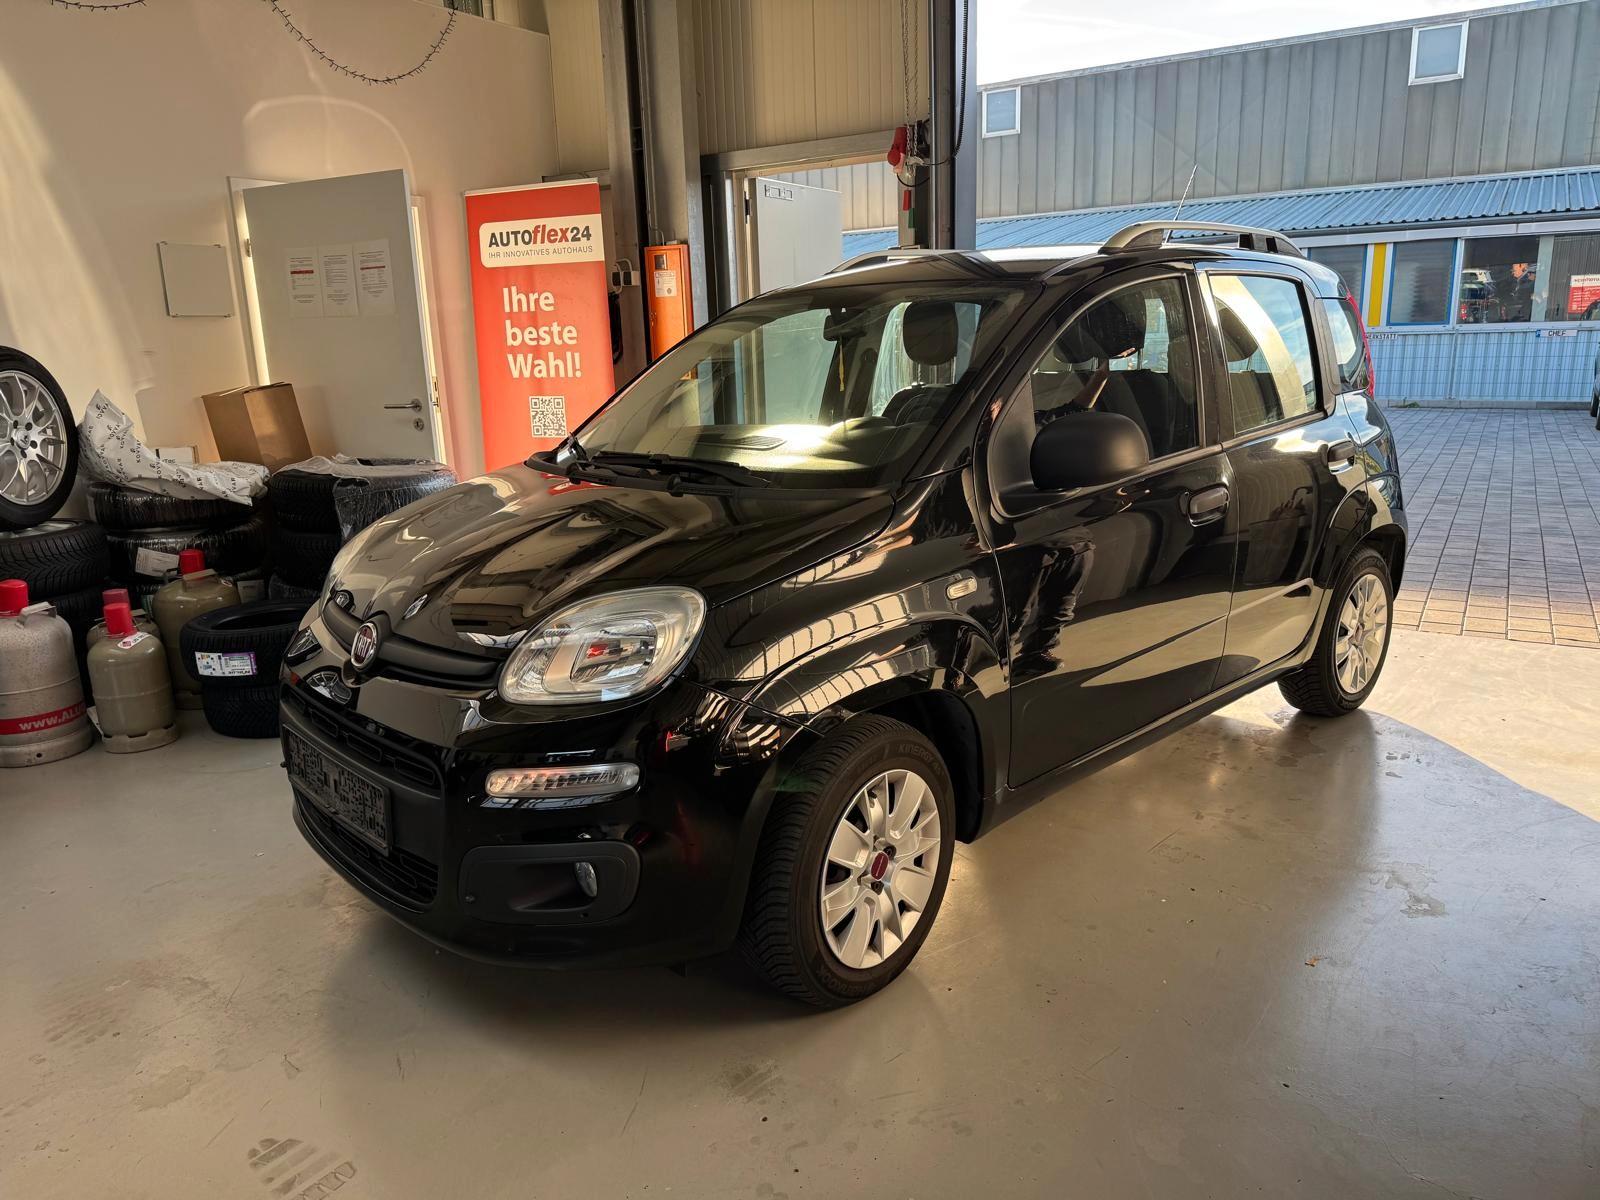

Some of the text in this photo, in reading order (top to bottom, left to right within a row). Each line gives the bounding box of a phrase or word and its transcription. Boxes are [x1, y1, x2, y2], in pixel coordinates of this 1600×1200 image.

[488, 224, 592, 248] AUTOflex24
[488, 245, 593, 259] IHR INNOVATIVES AUTOHAUS
[502, 285, 556, 313] Ihre
[505, 319, 578, 347] beste
[506, 351, 582, 379] Wahl!
[354, 634, 372, 658] FIAT
